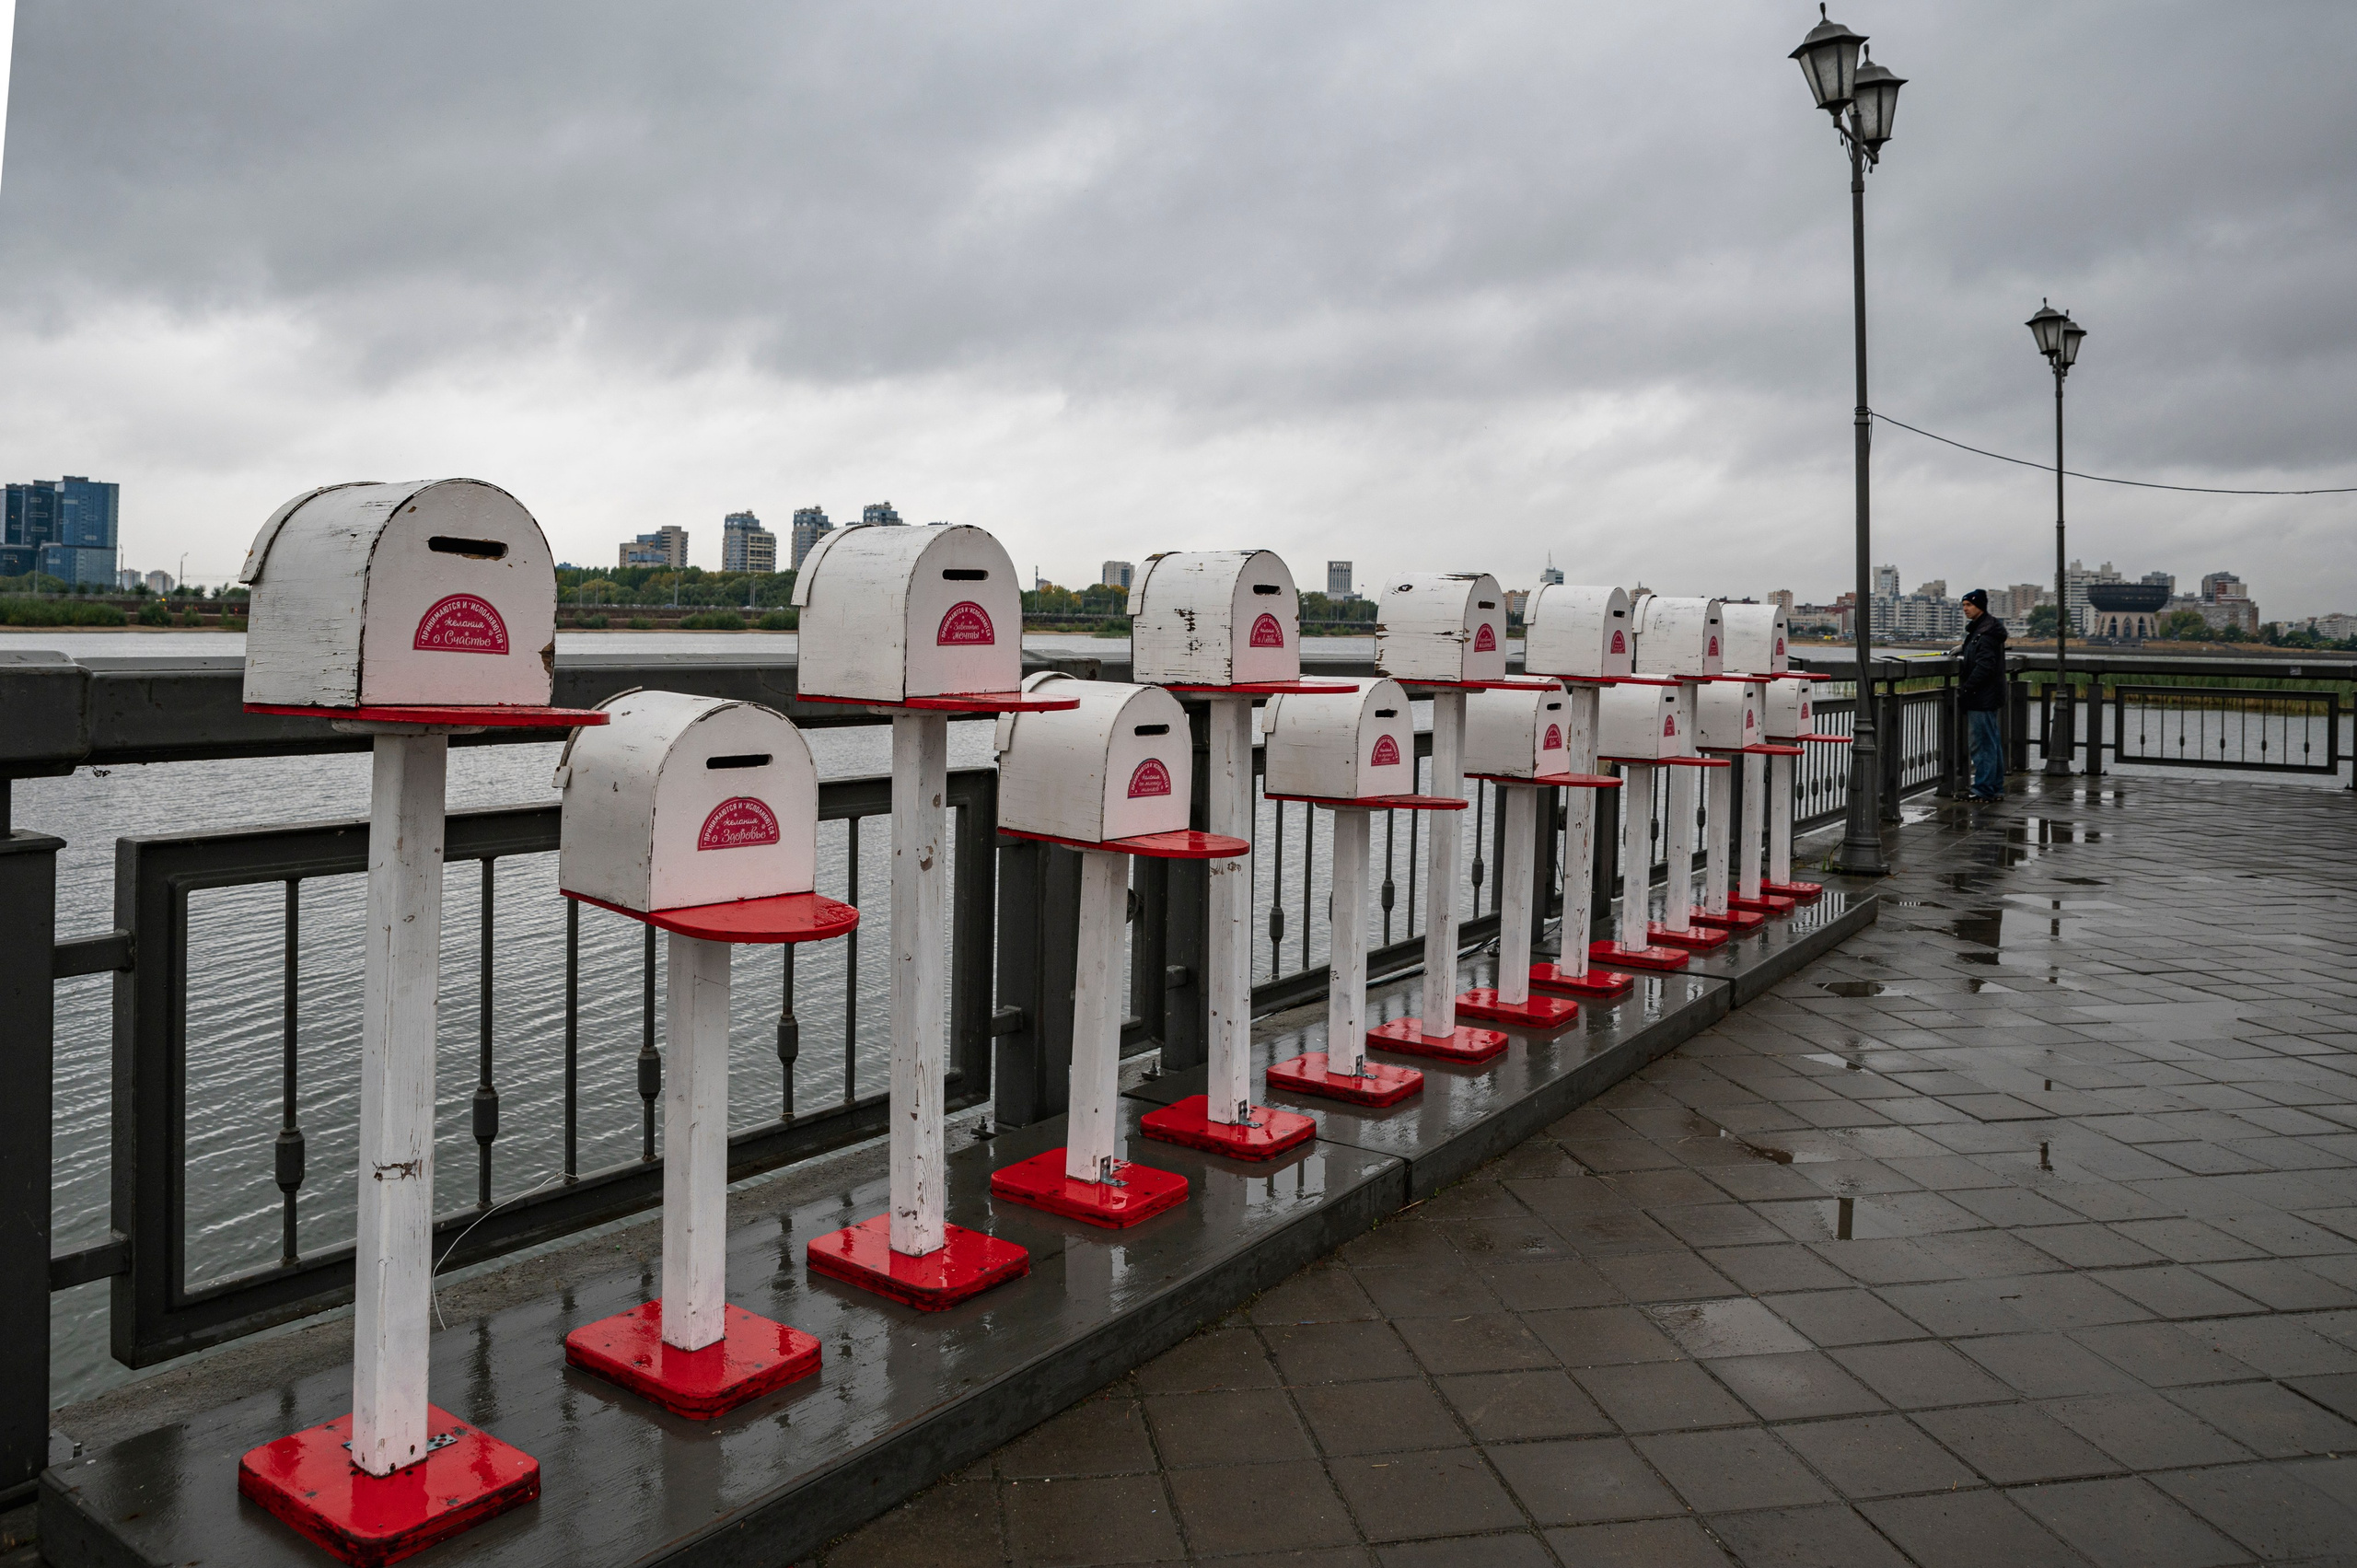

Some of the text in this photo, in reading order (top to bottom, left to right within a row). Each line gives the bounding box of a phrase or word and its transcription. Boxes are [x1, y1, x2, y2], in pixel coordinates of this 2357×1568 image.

[421, 600, 504, 645] ПРИНИМАЮТСЯ И ИСПОЛНЯЮТСЯ
[445, 629, 492, 647] Счастье
[704, 802, 737, 842] ПРИНИМАЮТСЯ
[745, 802, 775, 835] ИСПОЛНЯЮТСЯ
[721, 826, 767, 844] Здоровье
